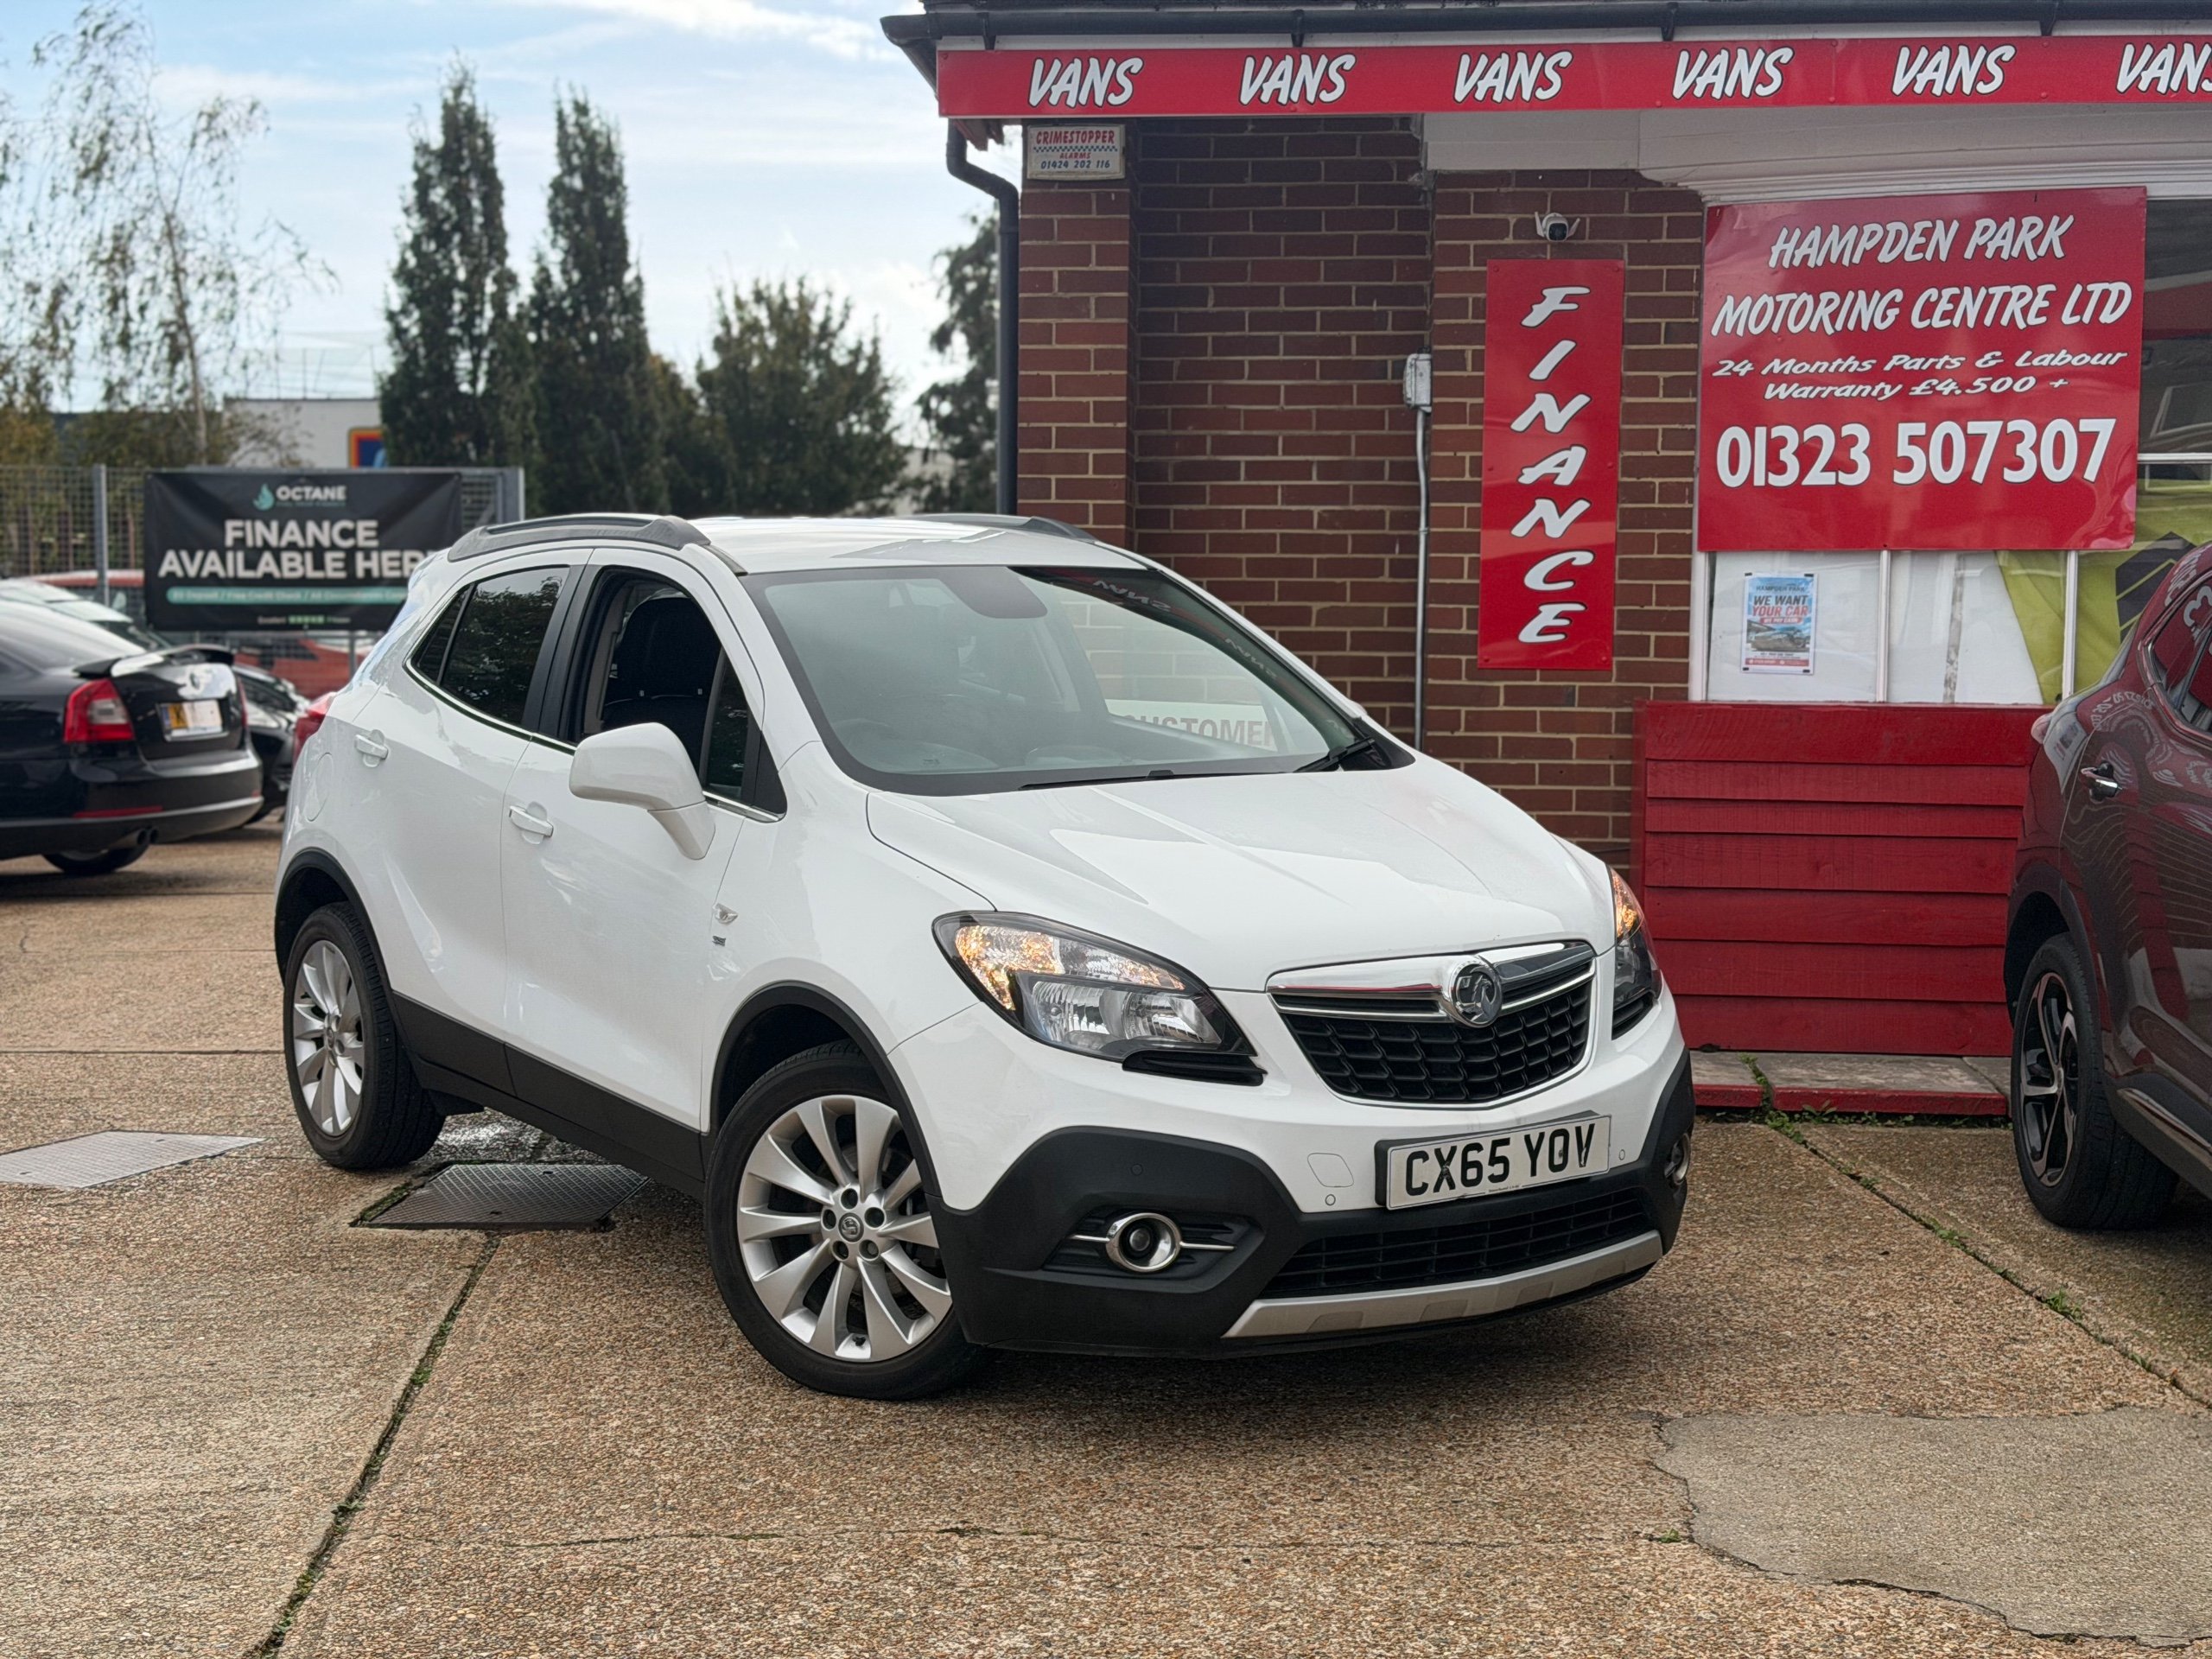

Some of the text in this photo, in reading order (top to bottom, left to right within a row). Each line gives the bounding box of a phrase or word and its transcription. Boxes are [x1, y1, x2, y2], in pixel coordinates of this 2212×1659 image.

[1027, 41, 2212, 108] VANS VANS VANS VANS VANS VAN
[1036, 130, 1115, 145] CRIMESTOPPER
[1040, 159, 1110, 169] 01424 202 116
[1769, 213, 2074, 269] HAMPDEN PARK
[1711, 281, 2133, 337] MOTORING CENTRE LTD
[1712, 348, 2129, 377] 24 Months Parts & Labour
[1764, 381, 1903, 400] Warranty
[1510, 285, 1595, 645] FINANCE
[1716, 418, 2117, 488] 01323 507307
[276, 486, 346, 501] OCTANE
[224, 519, 378, 548] FINANCE
[158, 550, 437, 579] AVAILABLE HER
[1752, 606, 1808, 616] YOUR CAR
[1754, 594, 1808, 606] WE WANT
[1405, 1123, 1595, 1197] CX65 YOV
